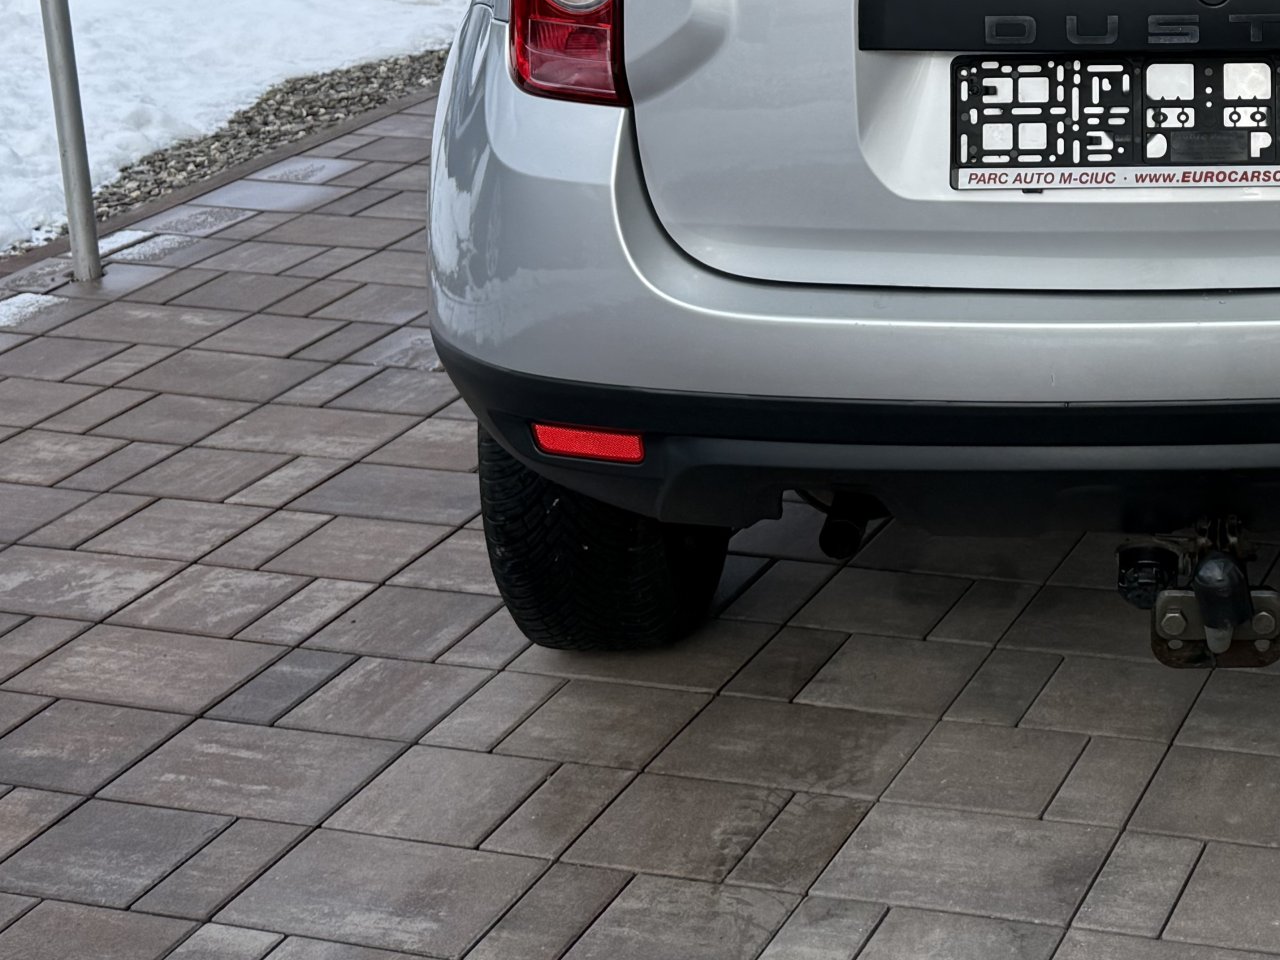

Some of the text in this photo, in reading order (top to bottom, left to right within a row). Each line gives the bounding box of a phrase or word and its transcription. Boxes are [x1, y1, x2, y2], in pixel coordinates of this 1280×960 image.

[968, 172, 1009, 184] PARC
[1012, 172, 1055, 184] AUTO
[1059, 171, 1116, 184] M-CIUC
